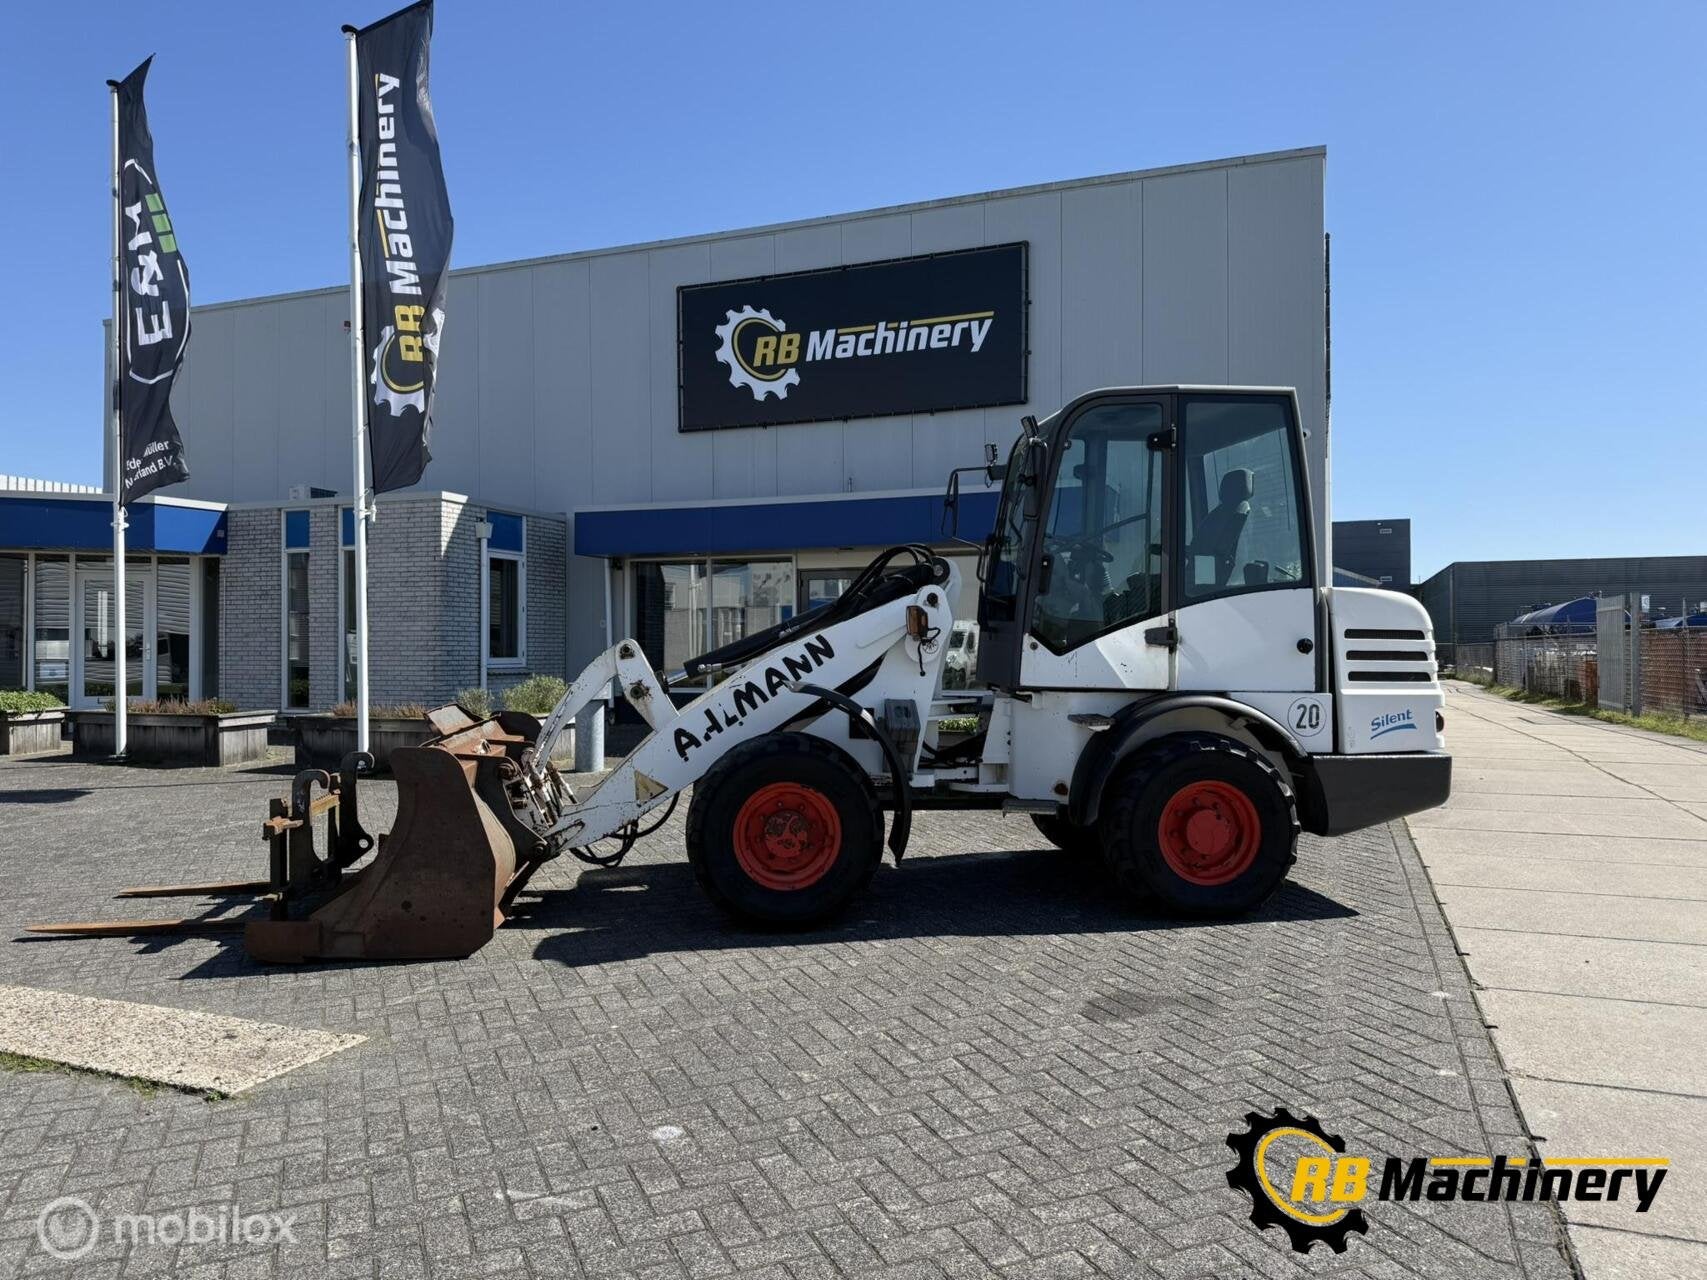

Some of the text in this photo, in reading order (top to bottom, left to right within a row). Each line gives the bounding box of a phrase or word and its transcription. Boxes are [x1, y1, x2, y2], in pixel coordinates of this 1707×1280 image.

[374, 72, 425, 362] RB Machinery
[753, 318, 992, 367] RB Machinery
[1295, 703, 1320, 730] 20
[1370, 709, 1413, 732] Silent
